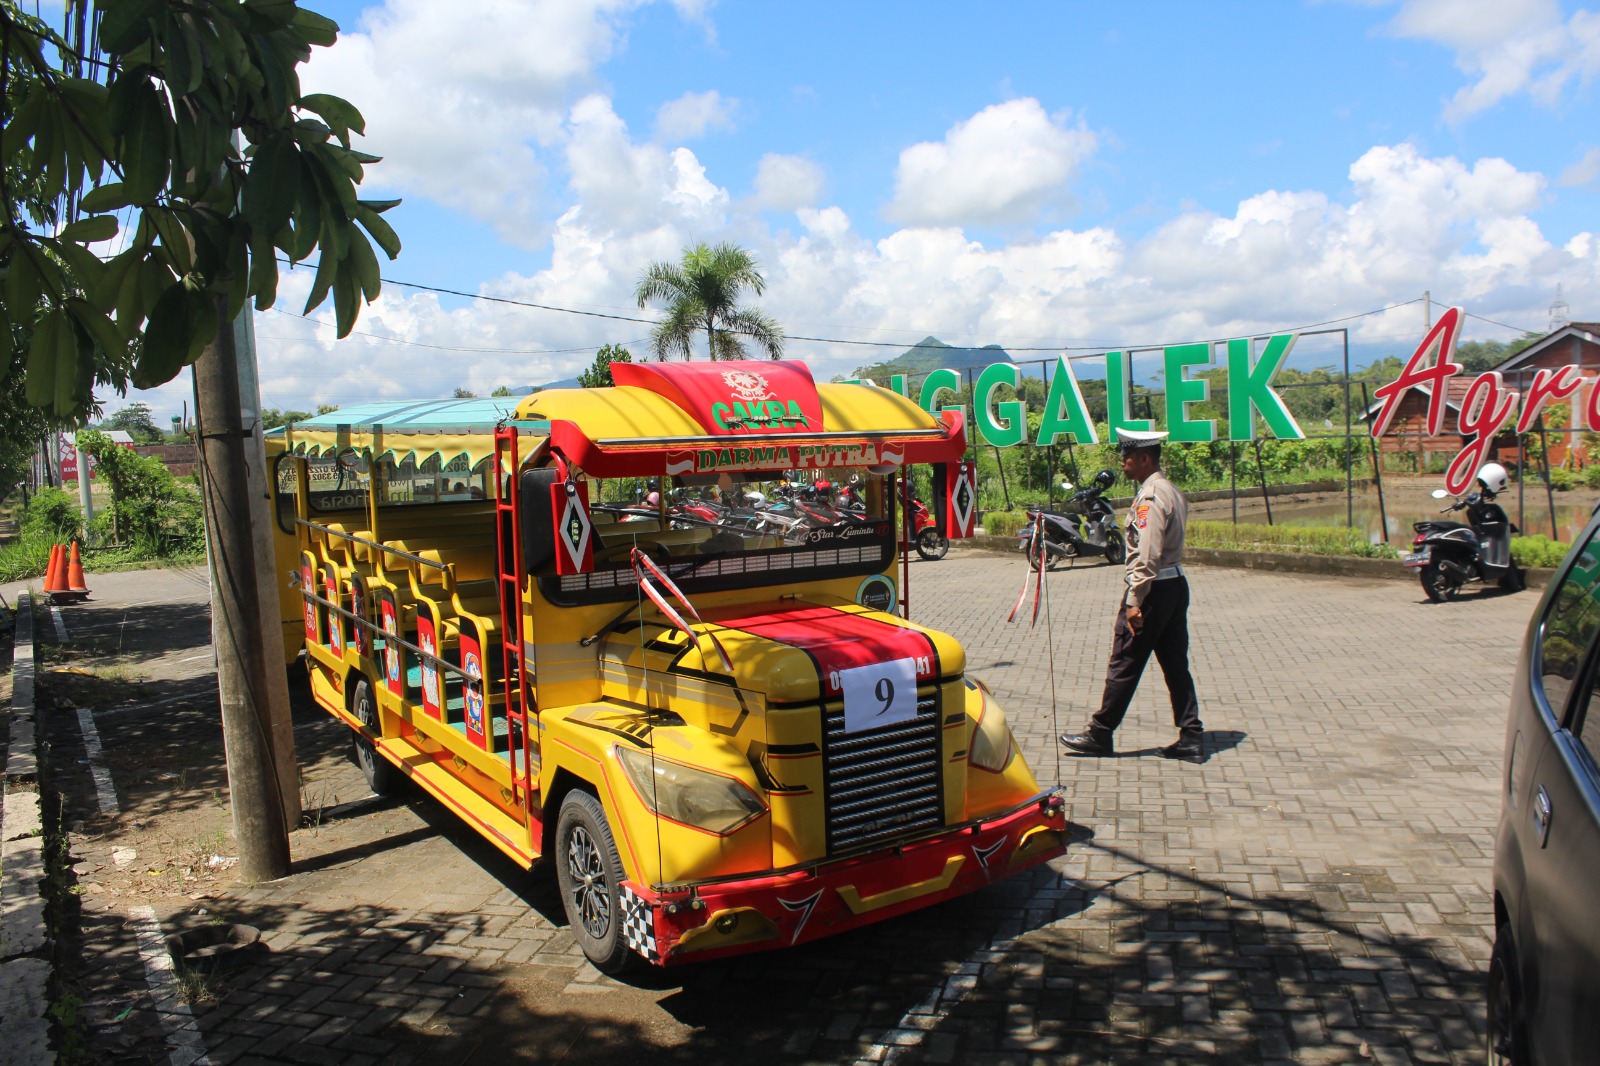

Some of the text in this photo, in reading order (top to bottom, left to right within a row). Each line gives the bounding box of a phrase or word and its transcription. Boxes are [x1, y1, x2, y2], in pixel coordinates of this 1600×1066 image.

[837, 333, 1306, 448] GGALEK
[711, 400, 810, 430] CAKRA
[697, 443, 879, 473] DARMA PUTRA
[810, 529, 834, 542] Star
[836, 526, 874, 540] Lumintu
[875, 677, 895, 717] 9
